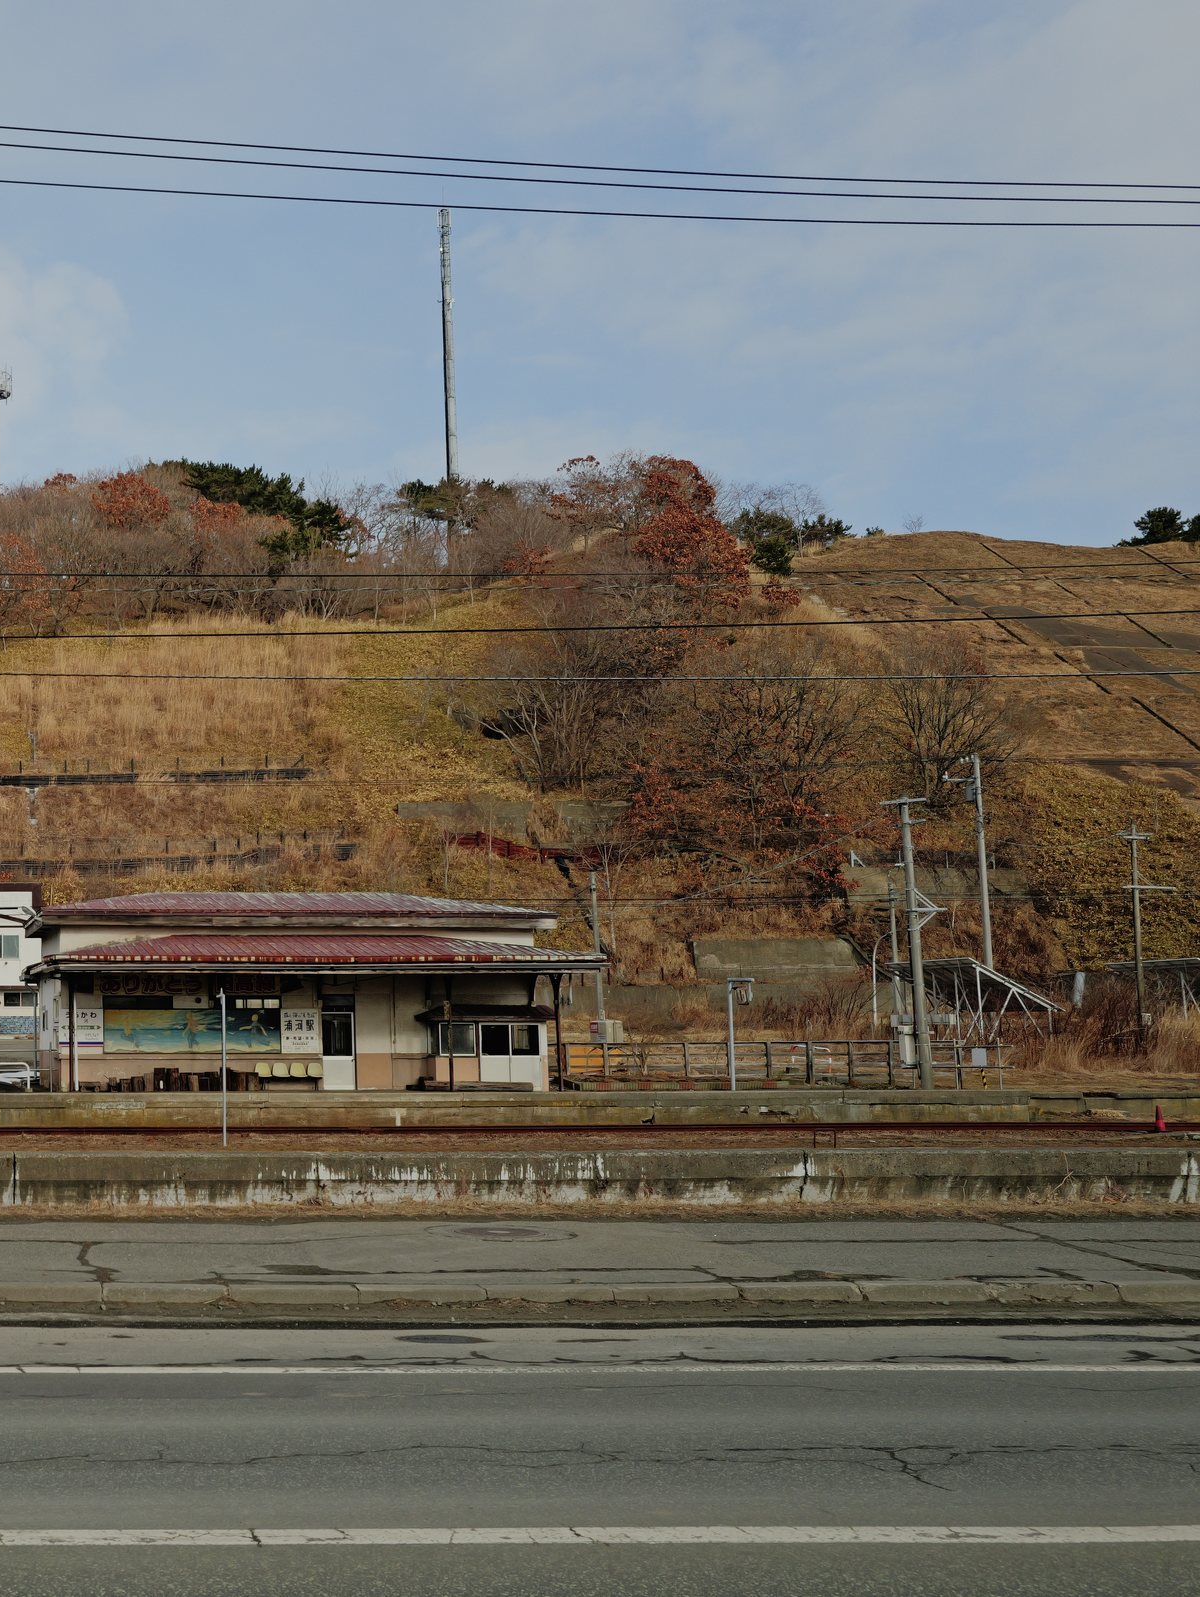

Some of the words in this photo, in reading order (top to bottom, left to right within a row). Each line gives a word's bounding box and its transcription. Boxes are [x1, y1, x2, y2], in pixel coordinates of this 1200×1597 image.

[99, 974, 202, 995] ありがとう
[284, 1019, 315, 1032] 浦河駅
